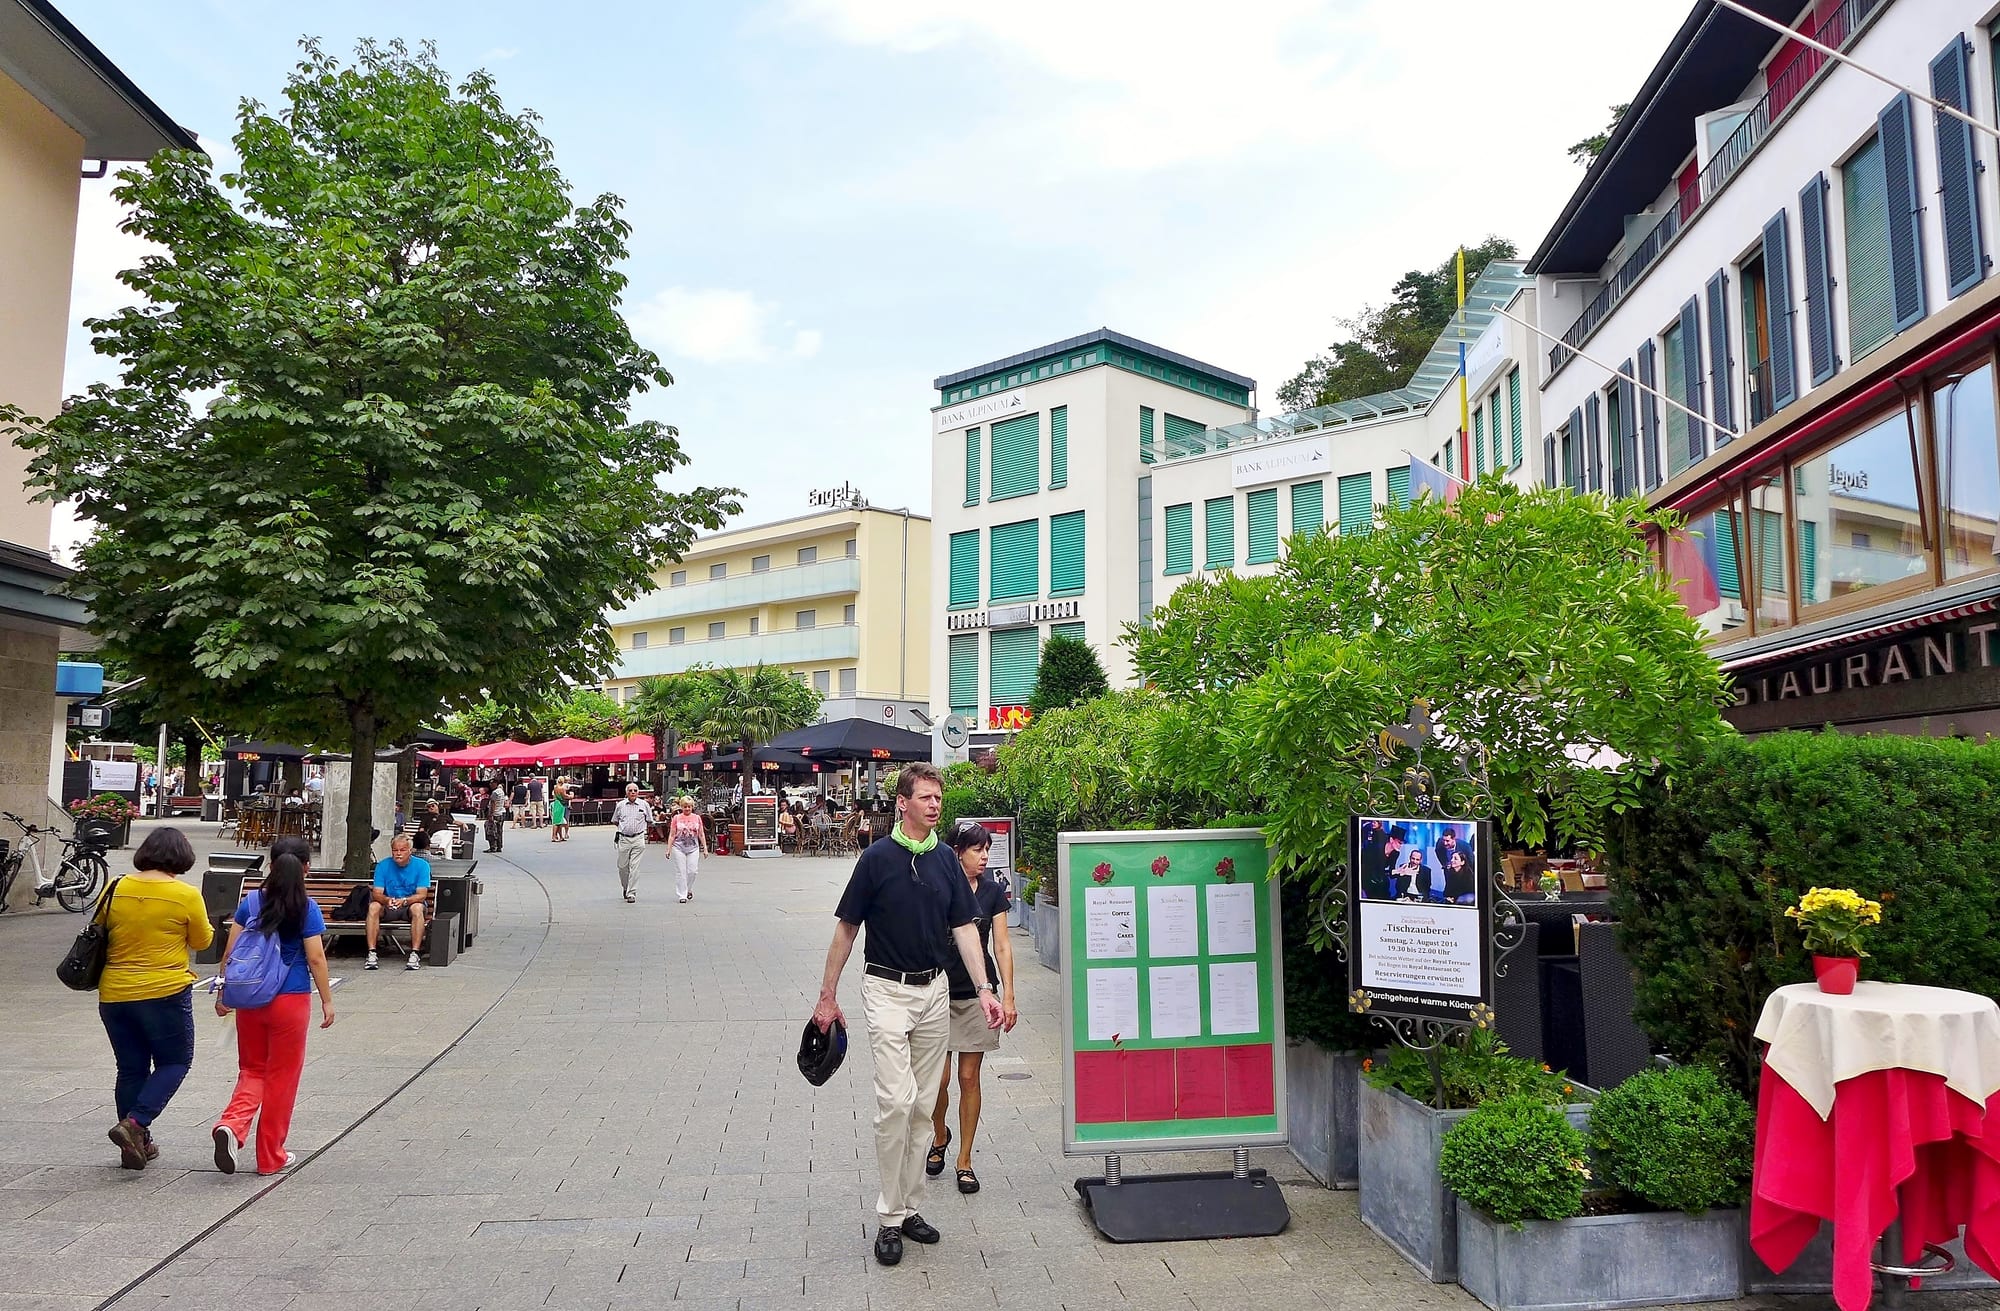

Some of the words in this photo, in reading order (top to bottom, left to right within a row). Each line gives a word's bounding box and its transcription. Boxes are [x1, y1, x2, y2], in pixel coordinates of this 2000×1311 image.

[941, 411, 965, 426] BANK
[967, 399, 1009, 419] ALPINUM
[1236, 461, 1263, 475] BANK
[1265, 452, 1310, 471] ALPINUM
[809, 480, 849, 508] Engel
[1416, 939, 1440, 948] August
[1440, 940, 1458, 948] 2014
[1417, 947, 1437, 955] 22.00
[1438, 948, 1451, 956] Uhr
[1374, 970, 1427, 981] Reservierungen
[1367, 990, 1419, 1004] Durchgehend
[1420, 997, 1448, 1007] warme
